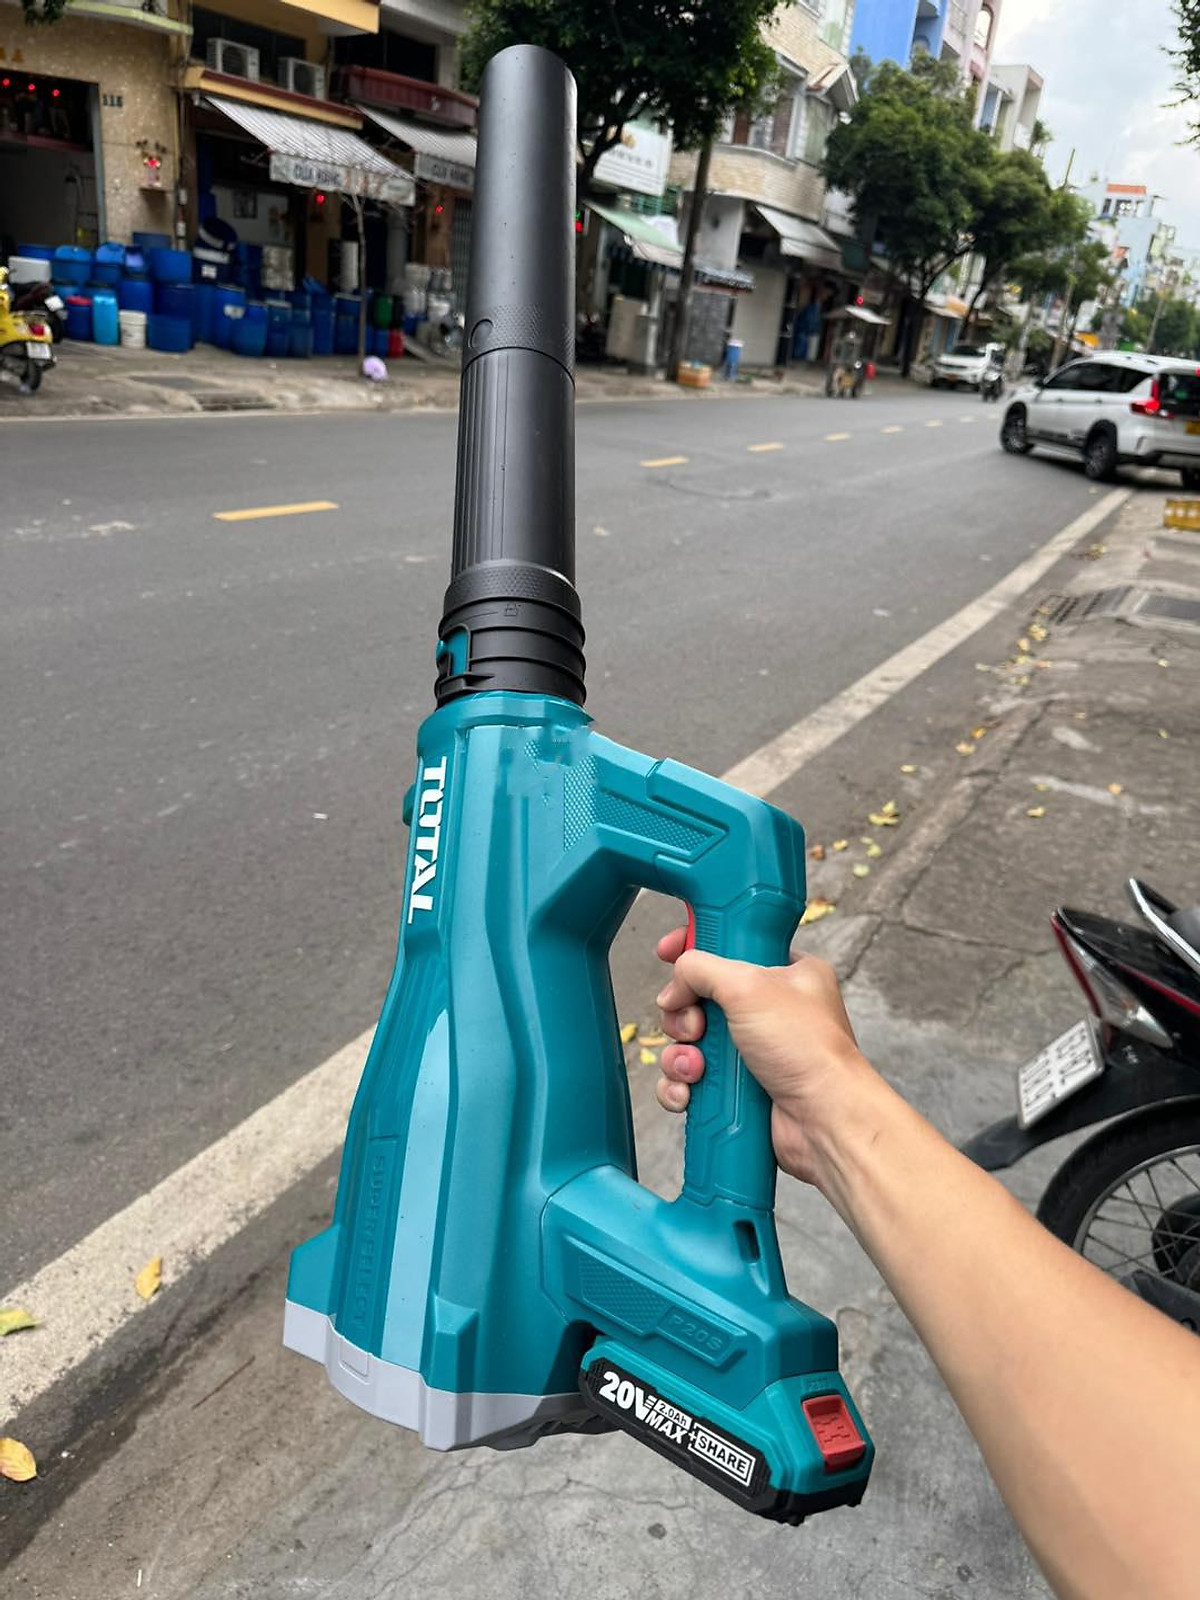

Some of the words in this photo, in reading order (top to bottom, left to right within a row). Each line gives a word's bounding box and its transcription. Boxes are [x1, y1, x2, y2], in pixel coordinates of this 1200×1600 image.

[407, 756, 448, 924] TOTAL
[668, 1313, 724, 1351] P20S
[599, 1371, 657, 1421] 20V
[659, 1402, 688, 1427] 2.0Ah
[645, 1410, 688, 1444] MAX
